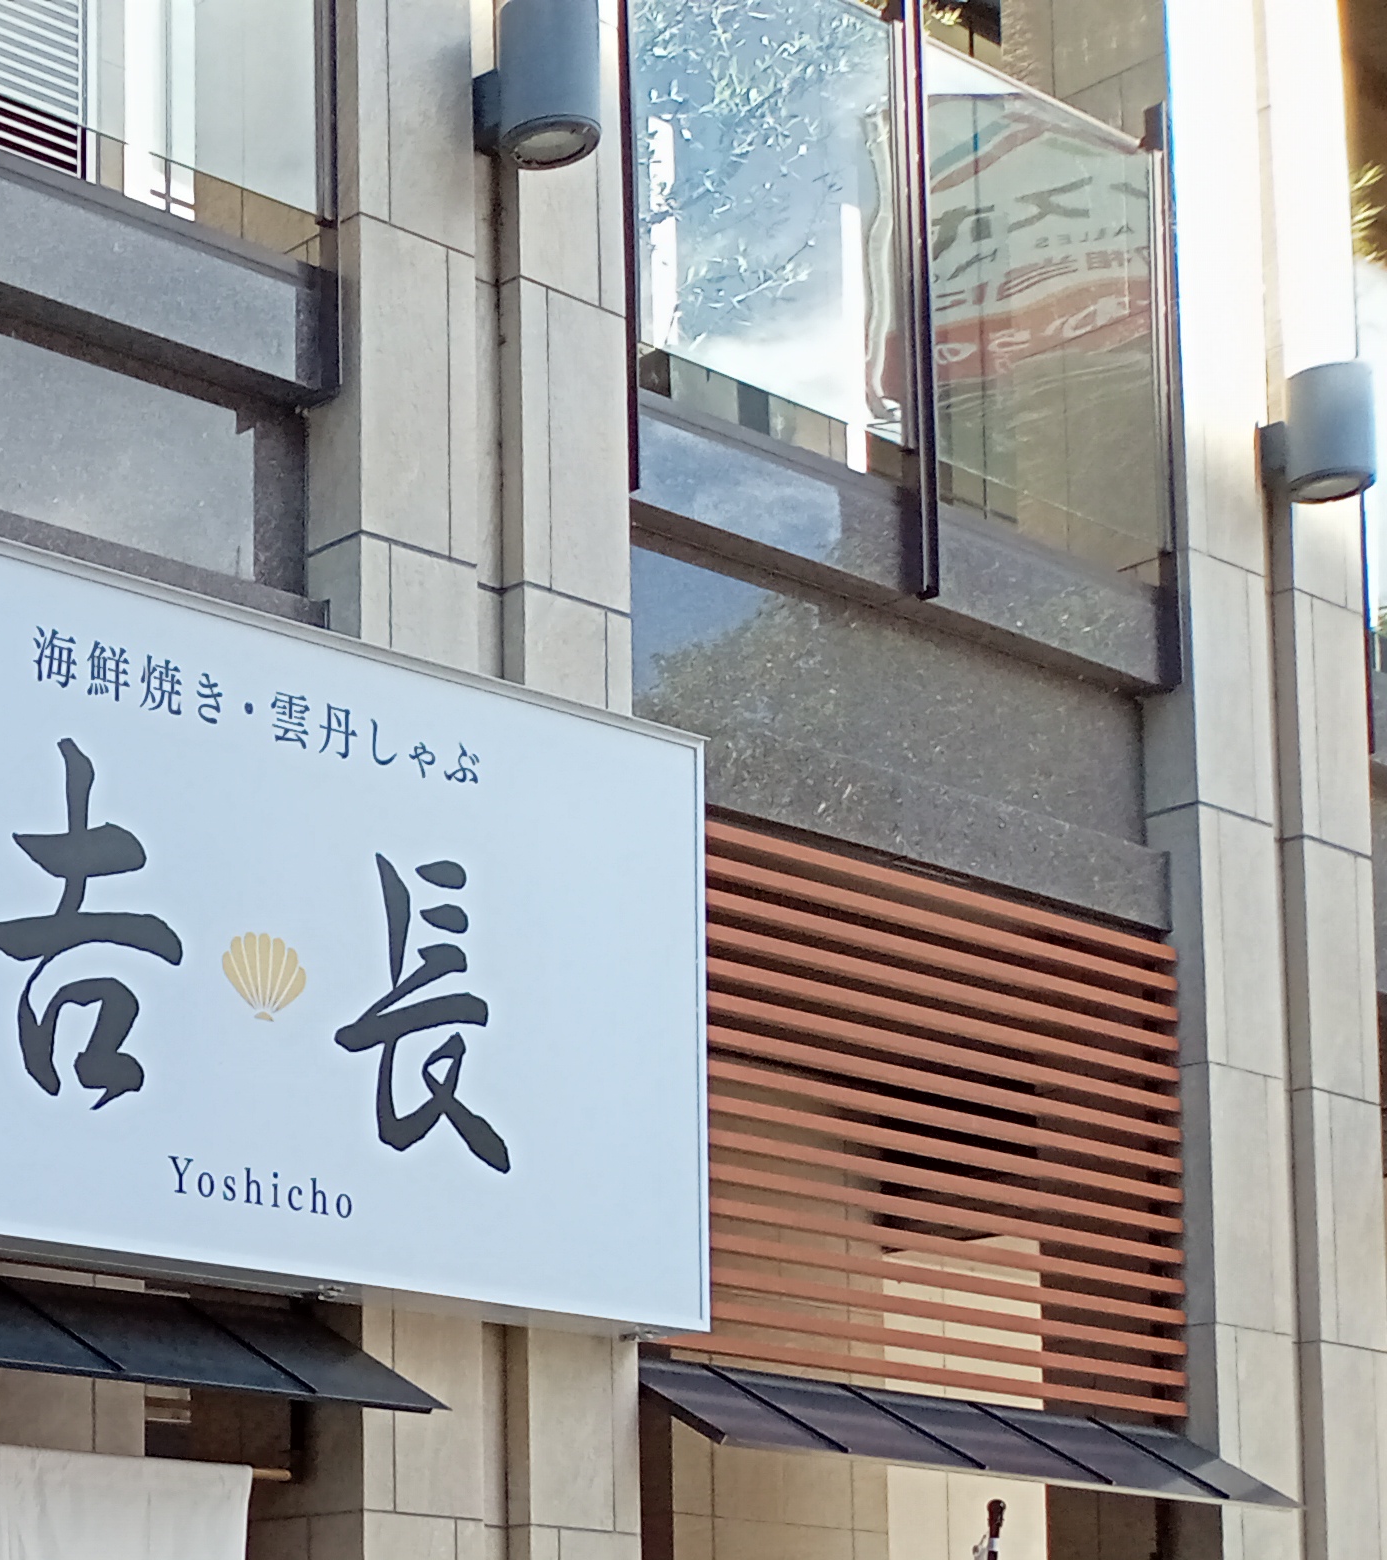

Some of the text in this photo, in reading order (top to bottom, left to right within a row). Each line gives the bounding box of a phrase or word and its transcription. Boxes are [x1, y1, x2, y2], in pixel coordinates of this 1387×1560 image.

[32, 625, 480, 784] 海鮮焼き・雲丹しゃぶ
[167, 1155, 354, 1219] Yoshicho
